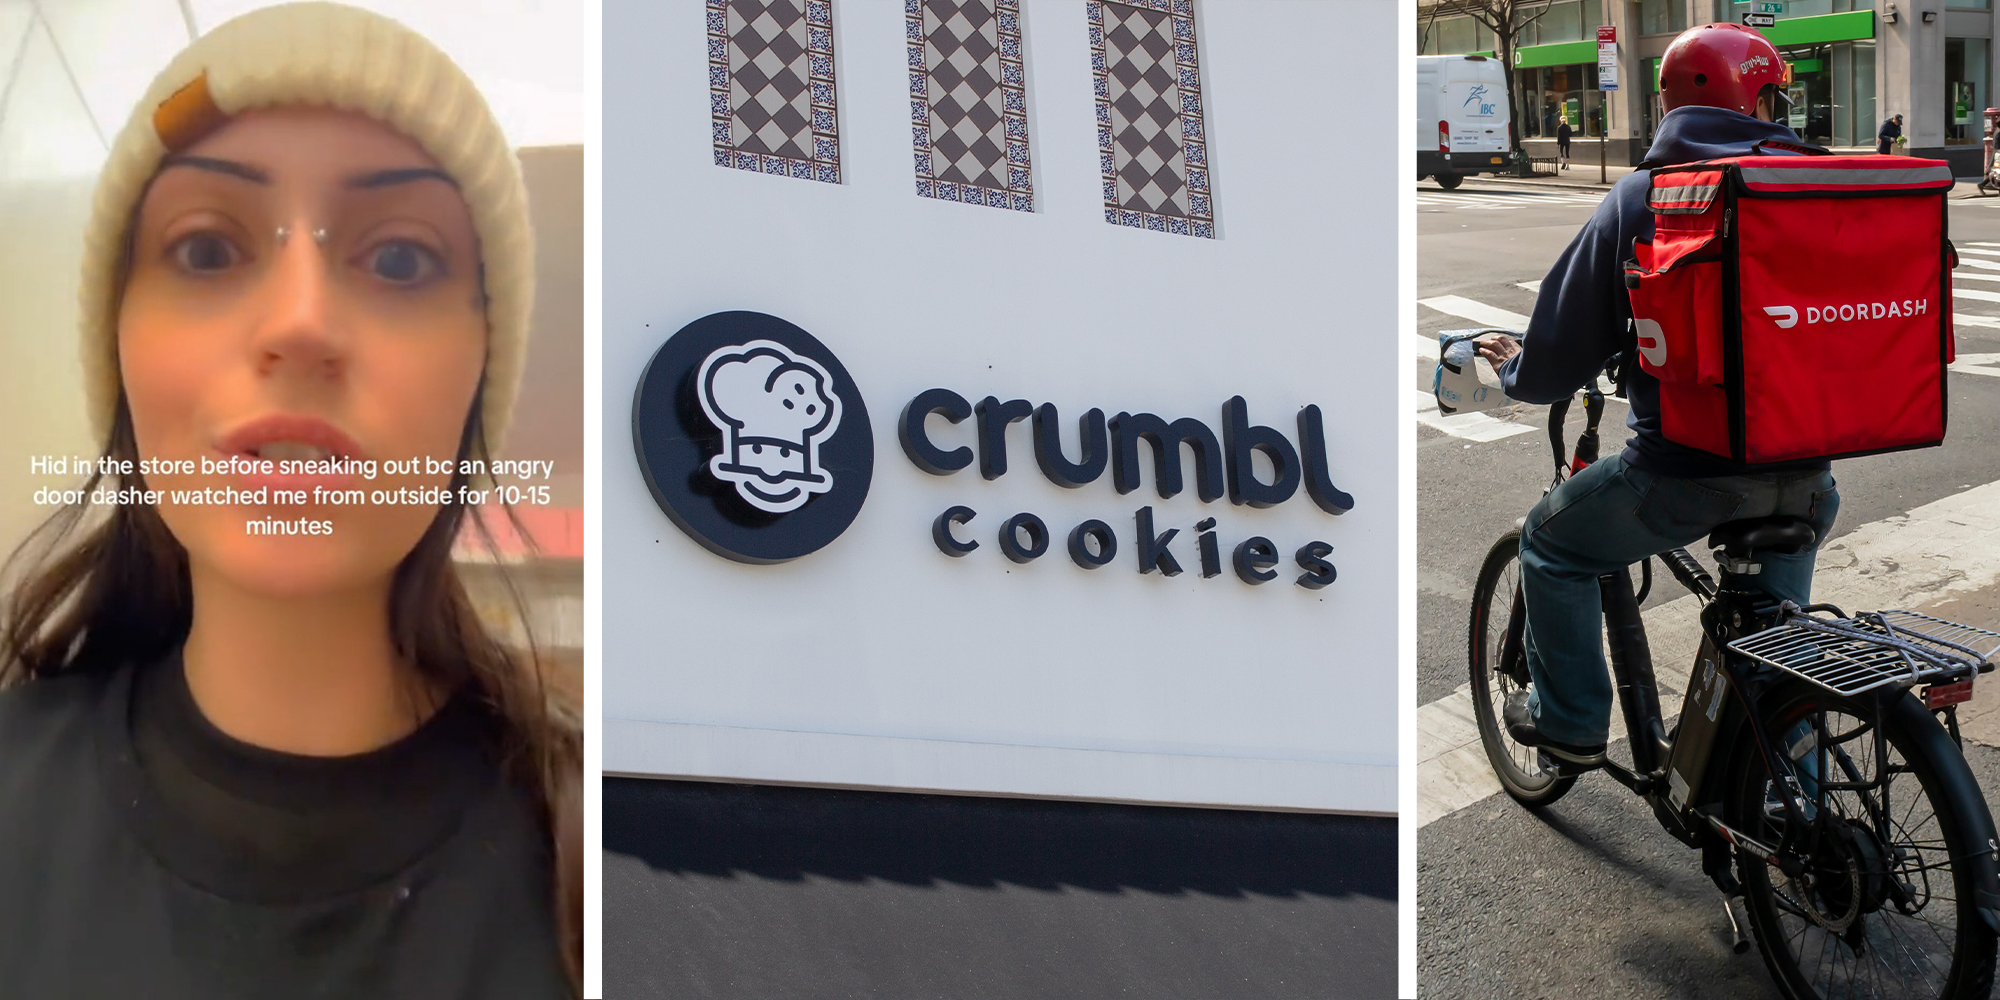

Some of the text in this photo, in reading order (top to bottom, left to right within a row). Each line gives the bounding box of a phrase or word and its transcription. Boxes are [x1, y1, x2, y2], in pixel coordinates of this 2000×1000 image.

[1767, 3, 1775, 12] 26
[1480, 103, 1496, 115] IBC
[1806, 299, 1927, 324] DOORDASH
[898, 388, 1355, 516] crumbl
[932, 505, 1337, 590] cookies
[1741, 840, 1769, 860] ARROW
